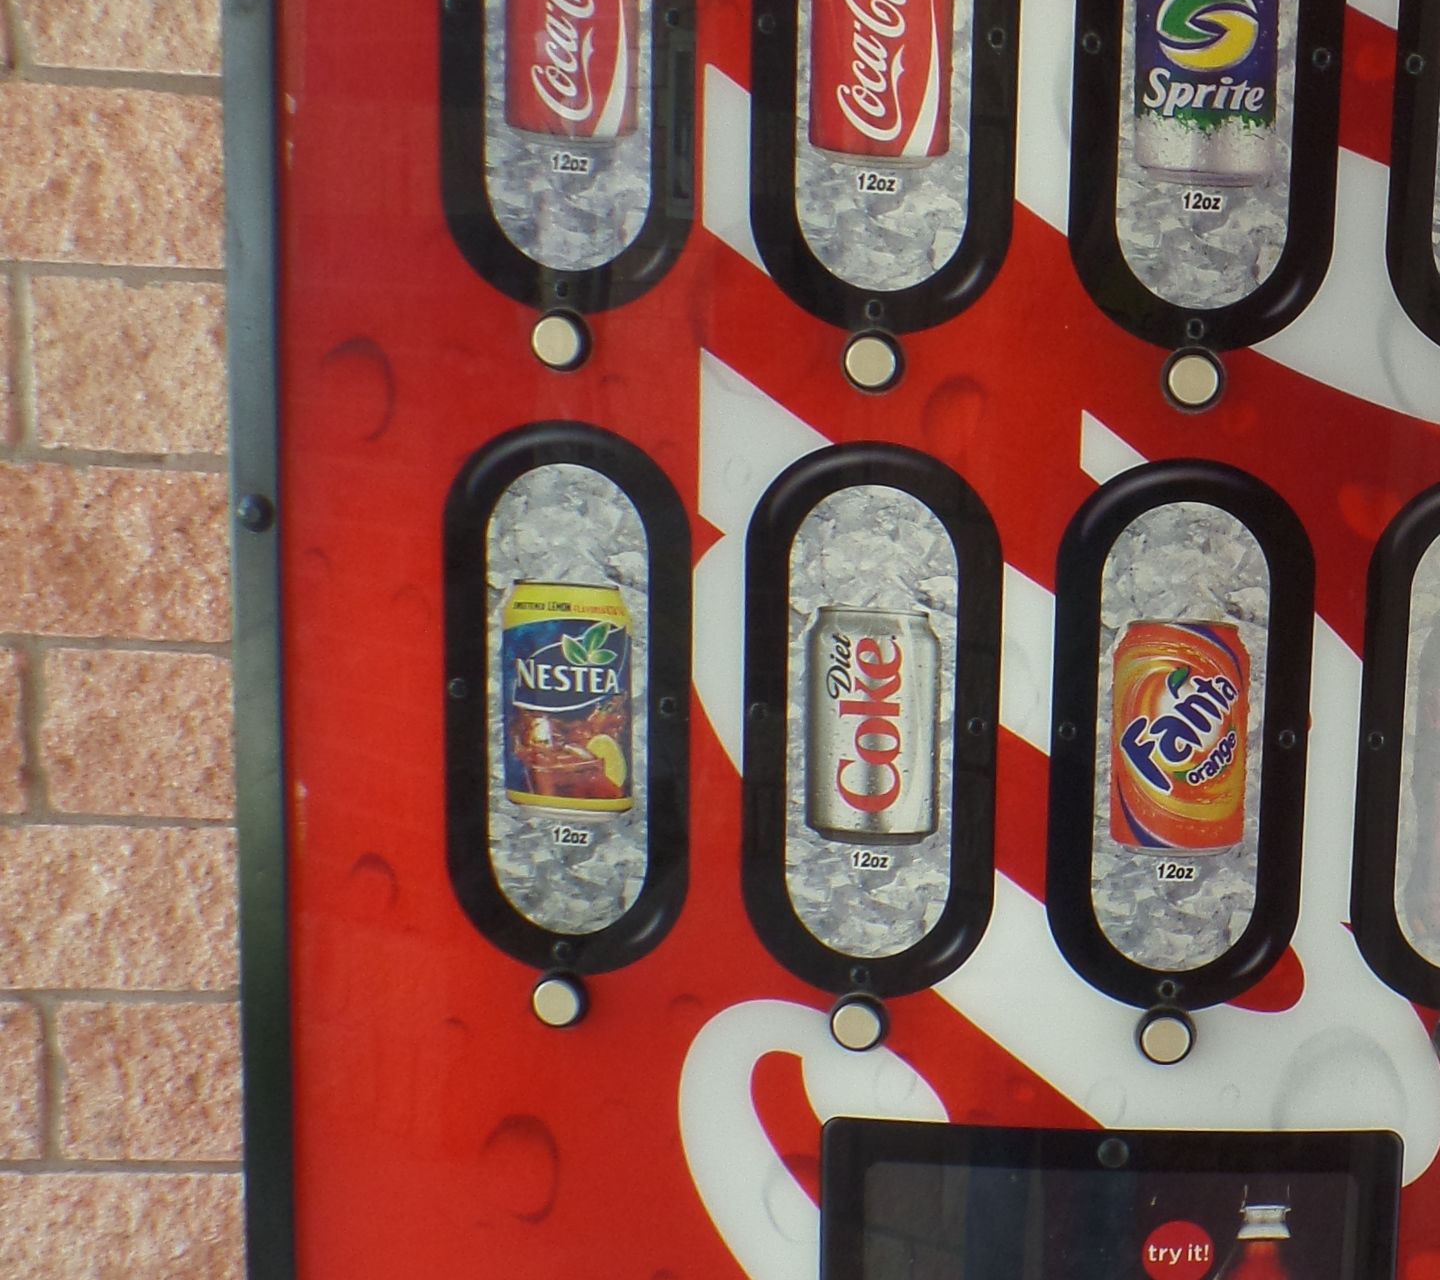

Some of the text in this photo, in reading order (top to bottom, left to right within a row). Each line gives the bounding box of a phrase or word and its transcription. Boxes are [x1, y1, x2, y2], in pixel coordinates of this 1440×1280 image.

[1143, 68, 1265, 116] Sprite
[551, 152, 589, 174] 12oz
[856, 172, 897, 194] 12oz
[1182, 192, 1222, 212] 12oz
[516, 657, 622, 695] NESTEA
[827, 632, 853, 700] Diet
[835, 635, 902, 813] Coke
[1120, 676, 1239, 793] Fanta
[1187, 731, 1237, 785] orange
[553, 828, 588, 846] 12oz
[852, 850, 889, 870] 12oz
[1157, 863, 1195, 881] 12oz
[1148, 1243, 1210, 1265] try it!
